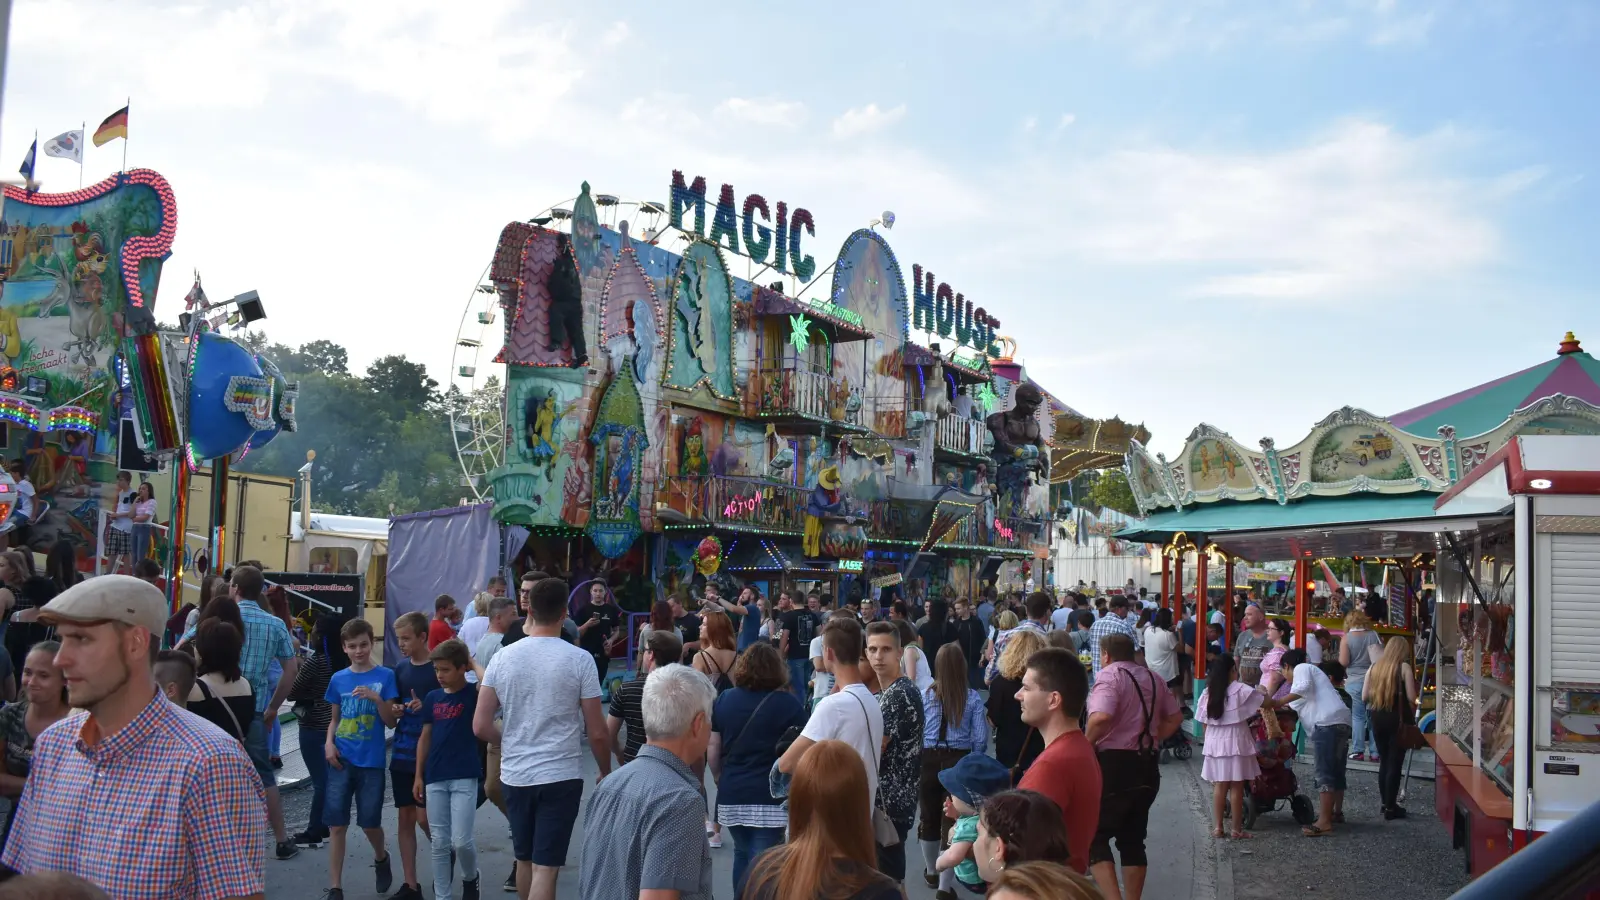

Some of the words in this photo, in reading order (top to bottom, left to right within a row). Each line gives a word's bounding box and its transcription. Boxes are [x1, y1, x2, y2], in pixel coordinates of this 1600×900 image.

[671, 169, 815, 283] MAGIC
[912, 263, 1000, 358] HOUSE
[811, 299, 863, 325] NTASTISCH
[724, 490, 762, 518] ACTION
[838, 559, 864, 571] KASSE
